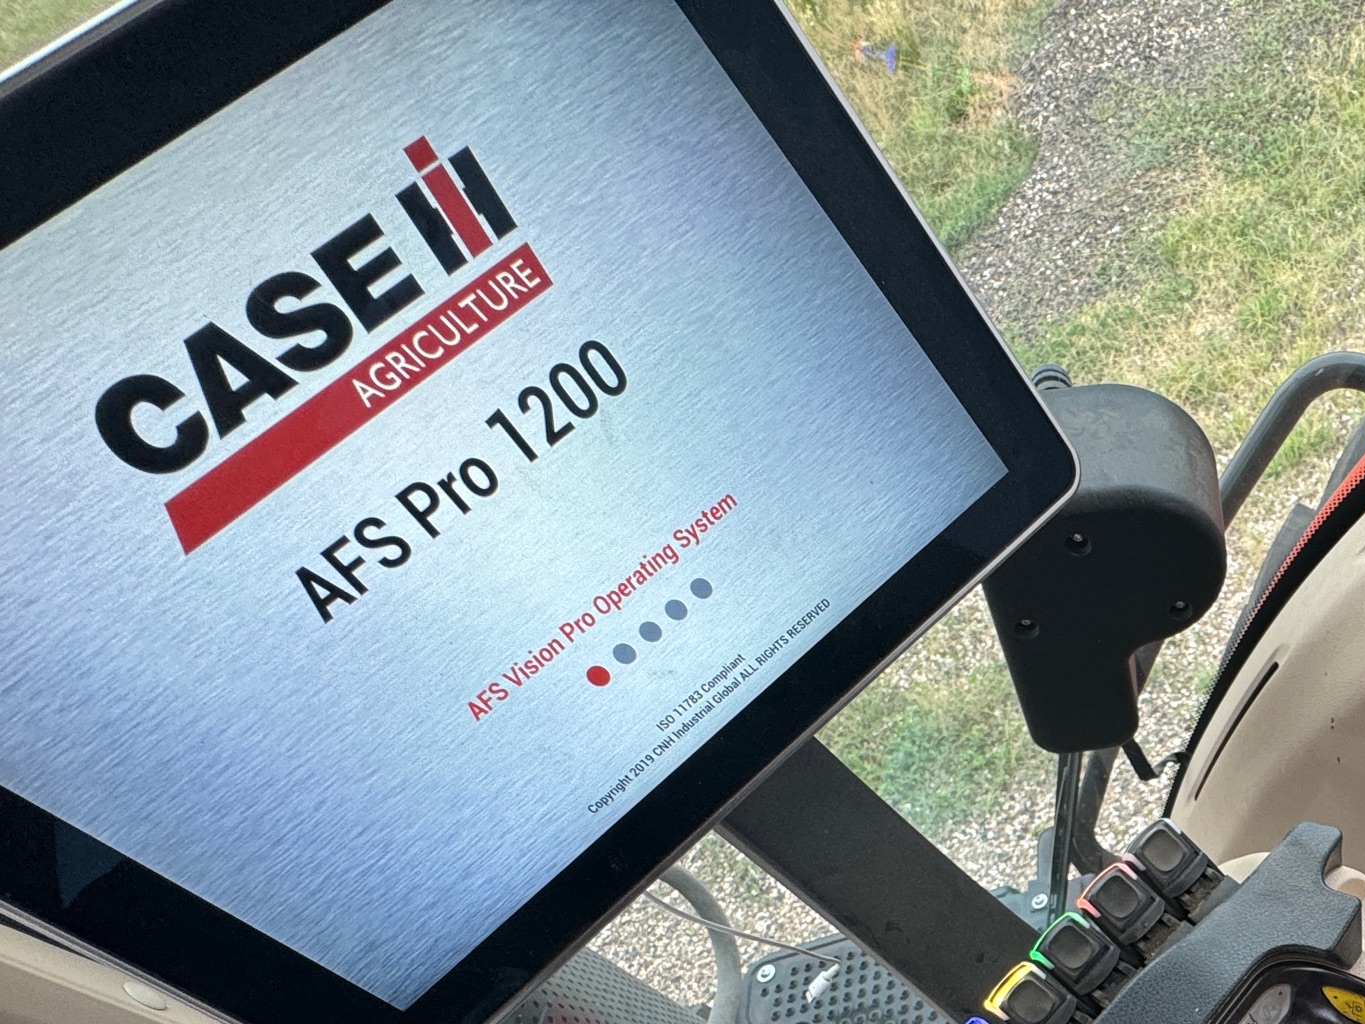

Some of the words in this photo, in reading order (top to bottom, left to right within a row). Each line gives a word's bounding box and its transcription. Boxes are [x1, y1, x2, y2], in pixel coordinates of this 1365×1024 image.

[94, 212, 426, 475] CASE
[350, 256, 542, 409] AGRICULTURE
[295, 516, 412, 625] AFS
[394, 457, 499, 540] Pro
[484, 339, 628, 463] 1200
[467, 681, 510, 722] AFS
[501, 638, 566, 688] Vision
[558, 612, 596, 644] Pro
[592, 543, 680, 615] Operating
[672, 493, 738, 549] System
[587, 774, 634, 814] Copyright
[629, 754, 655, 778] 2019
[652, 735, 676, 757] CNH
[672, 700, 716, 740] Industrial
[712, 677, 742, 704] Global
[739, 663, 759, 682] ALL
[755, 635, 789, 667] RIGHTS
[786, 598, 830, 639] RESERVED
[655, 714, 676, 732] ISO
[673, 690, 704, 717] 11783
[700, 653, 746, 694] Compliant
